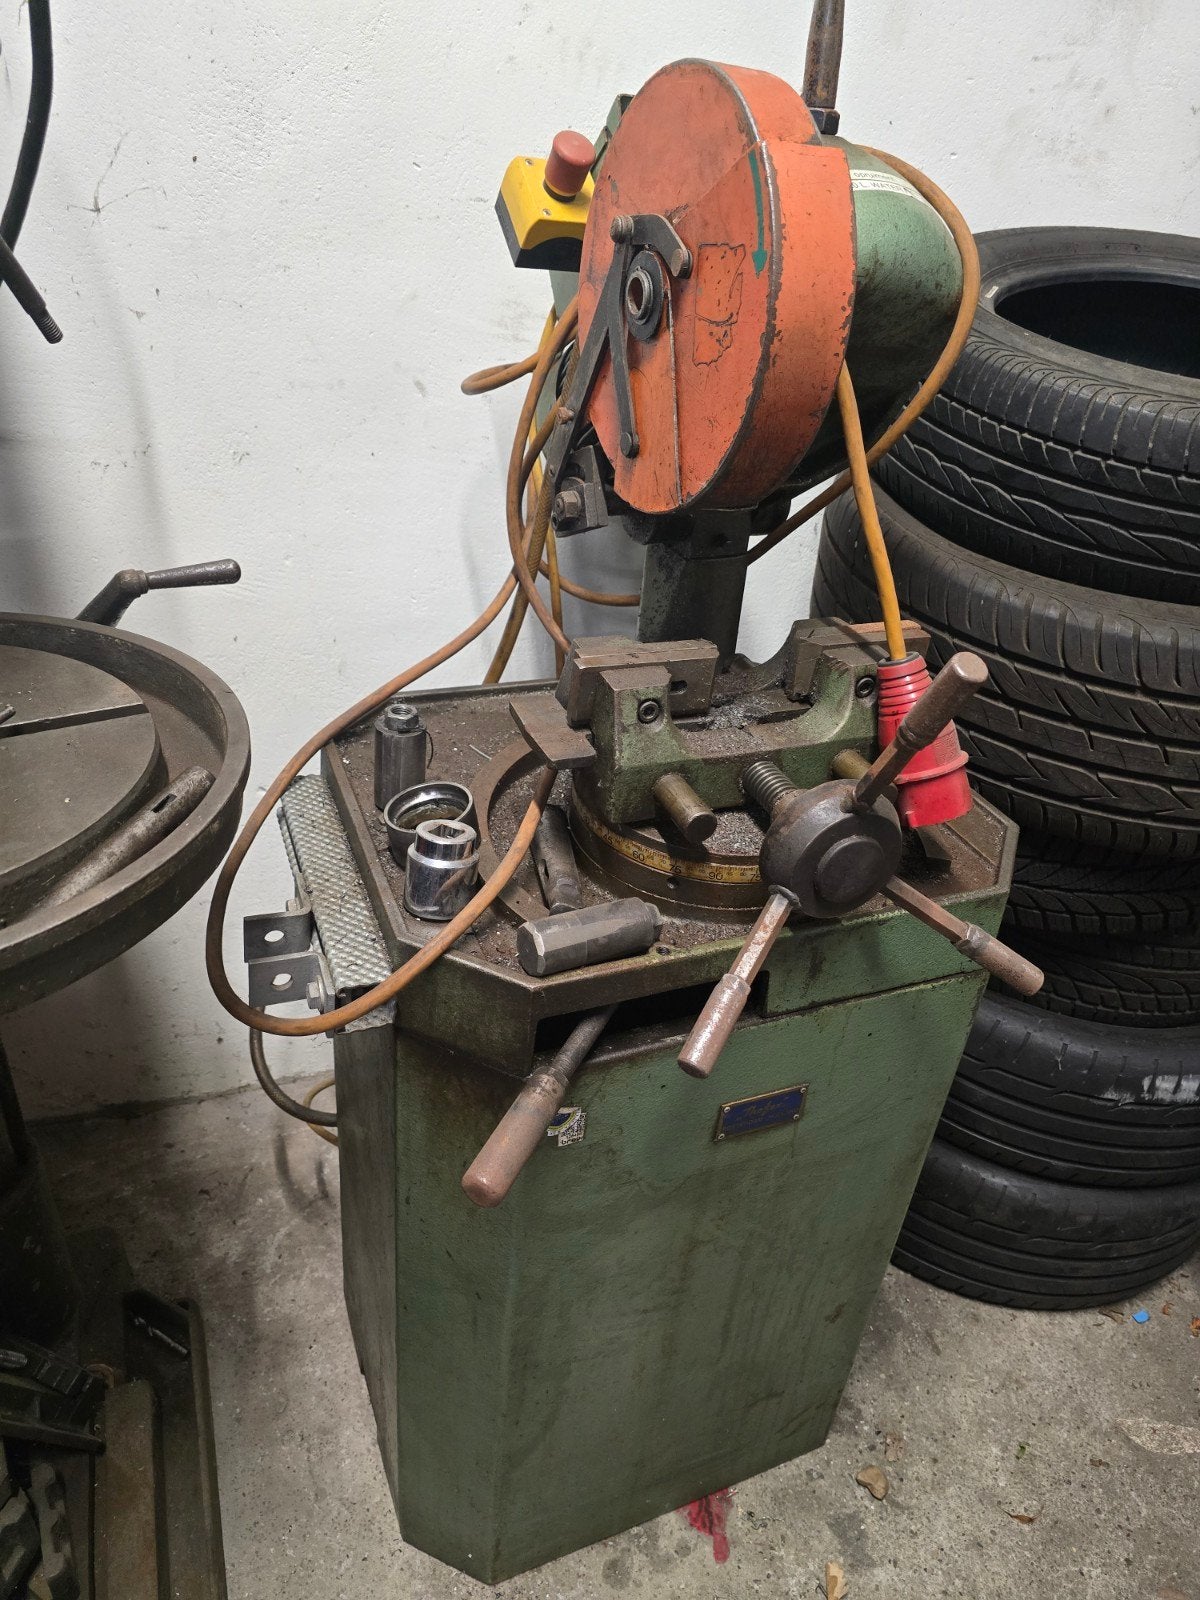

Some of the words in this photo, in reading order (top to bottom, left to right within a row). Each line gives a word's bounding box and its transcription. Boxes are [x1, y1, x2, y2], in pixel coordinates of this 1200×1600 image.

[632, 850, 645, 862] 60
[669, 863, 682, 874] 75
[708, 871, 723, 881] 90
